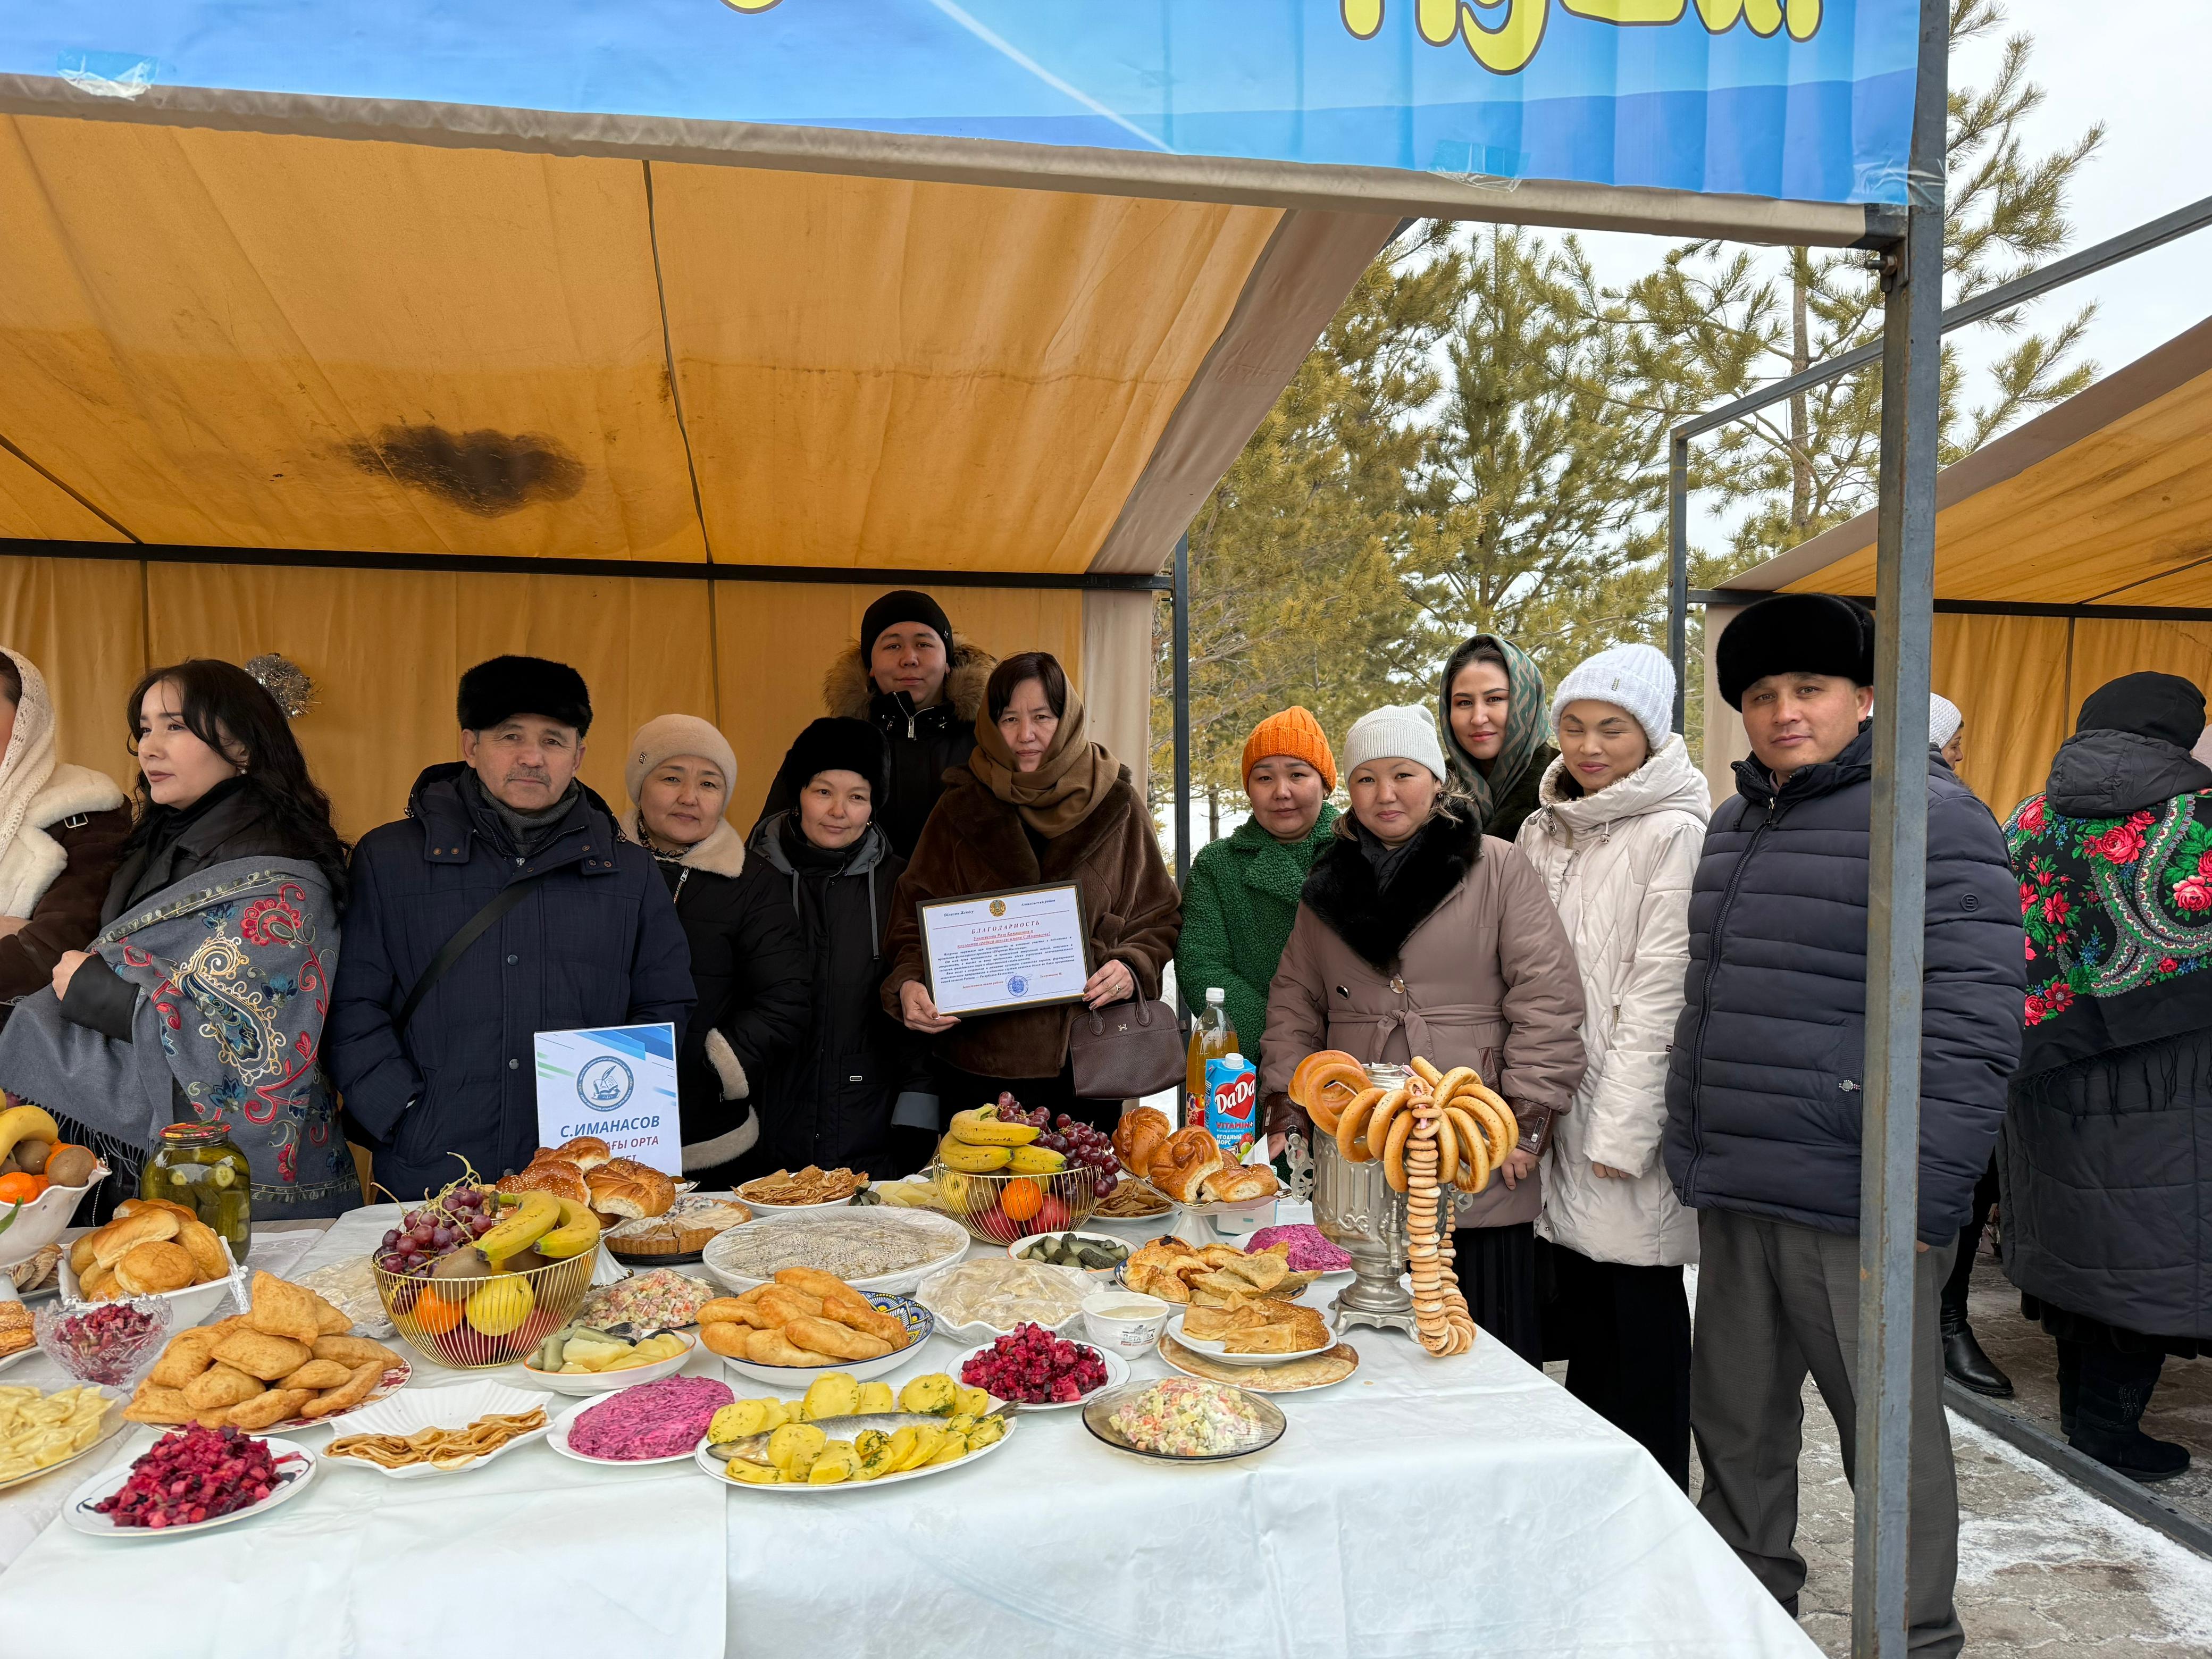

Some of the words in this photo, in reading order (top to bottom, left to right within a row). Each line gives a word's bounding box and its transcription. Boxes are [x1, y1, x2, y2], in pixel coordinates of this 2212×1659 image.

[971, 920, 1040, 934] БЛАГОДАРНОСТЬ
[1214, 1079, 1255, 1115] DaDa
[560, 1116, 660, 1138] С.ИМАНАСОВ
[606, 1139, 627, 1150] АҒЫ
[631, 1136, 659, 1147] ОРТА
